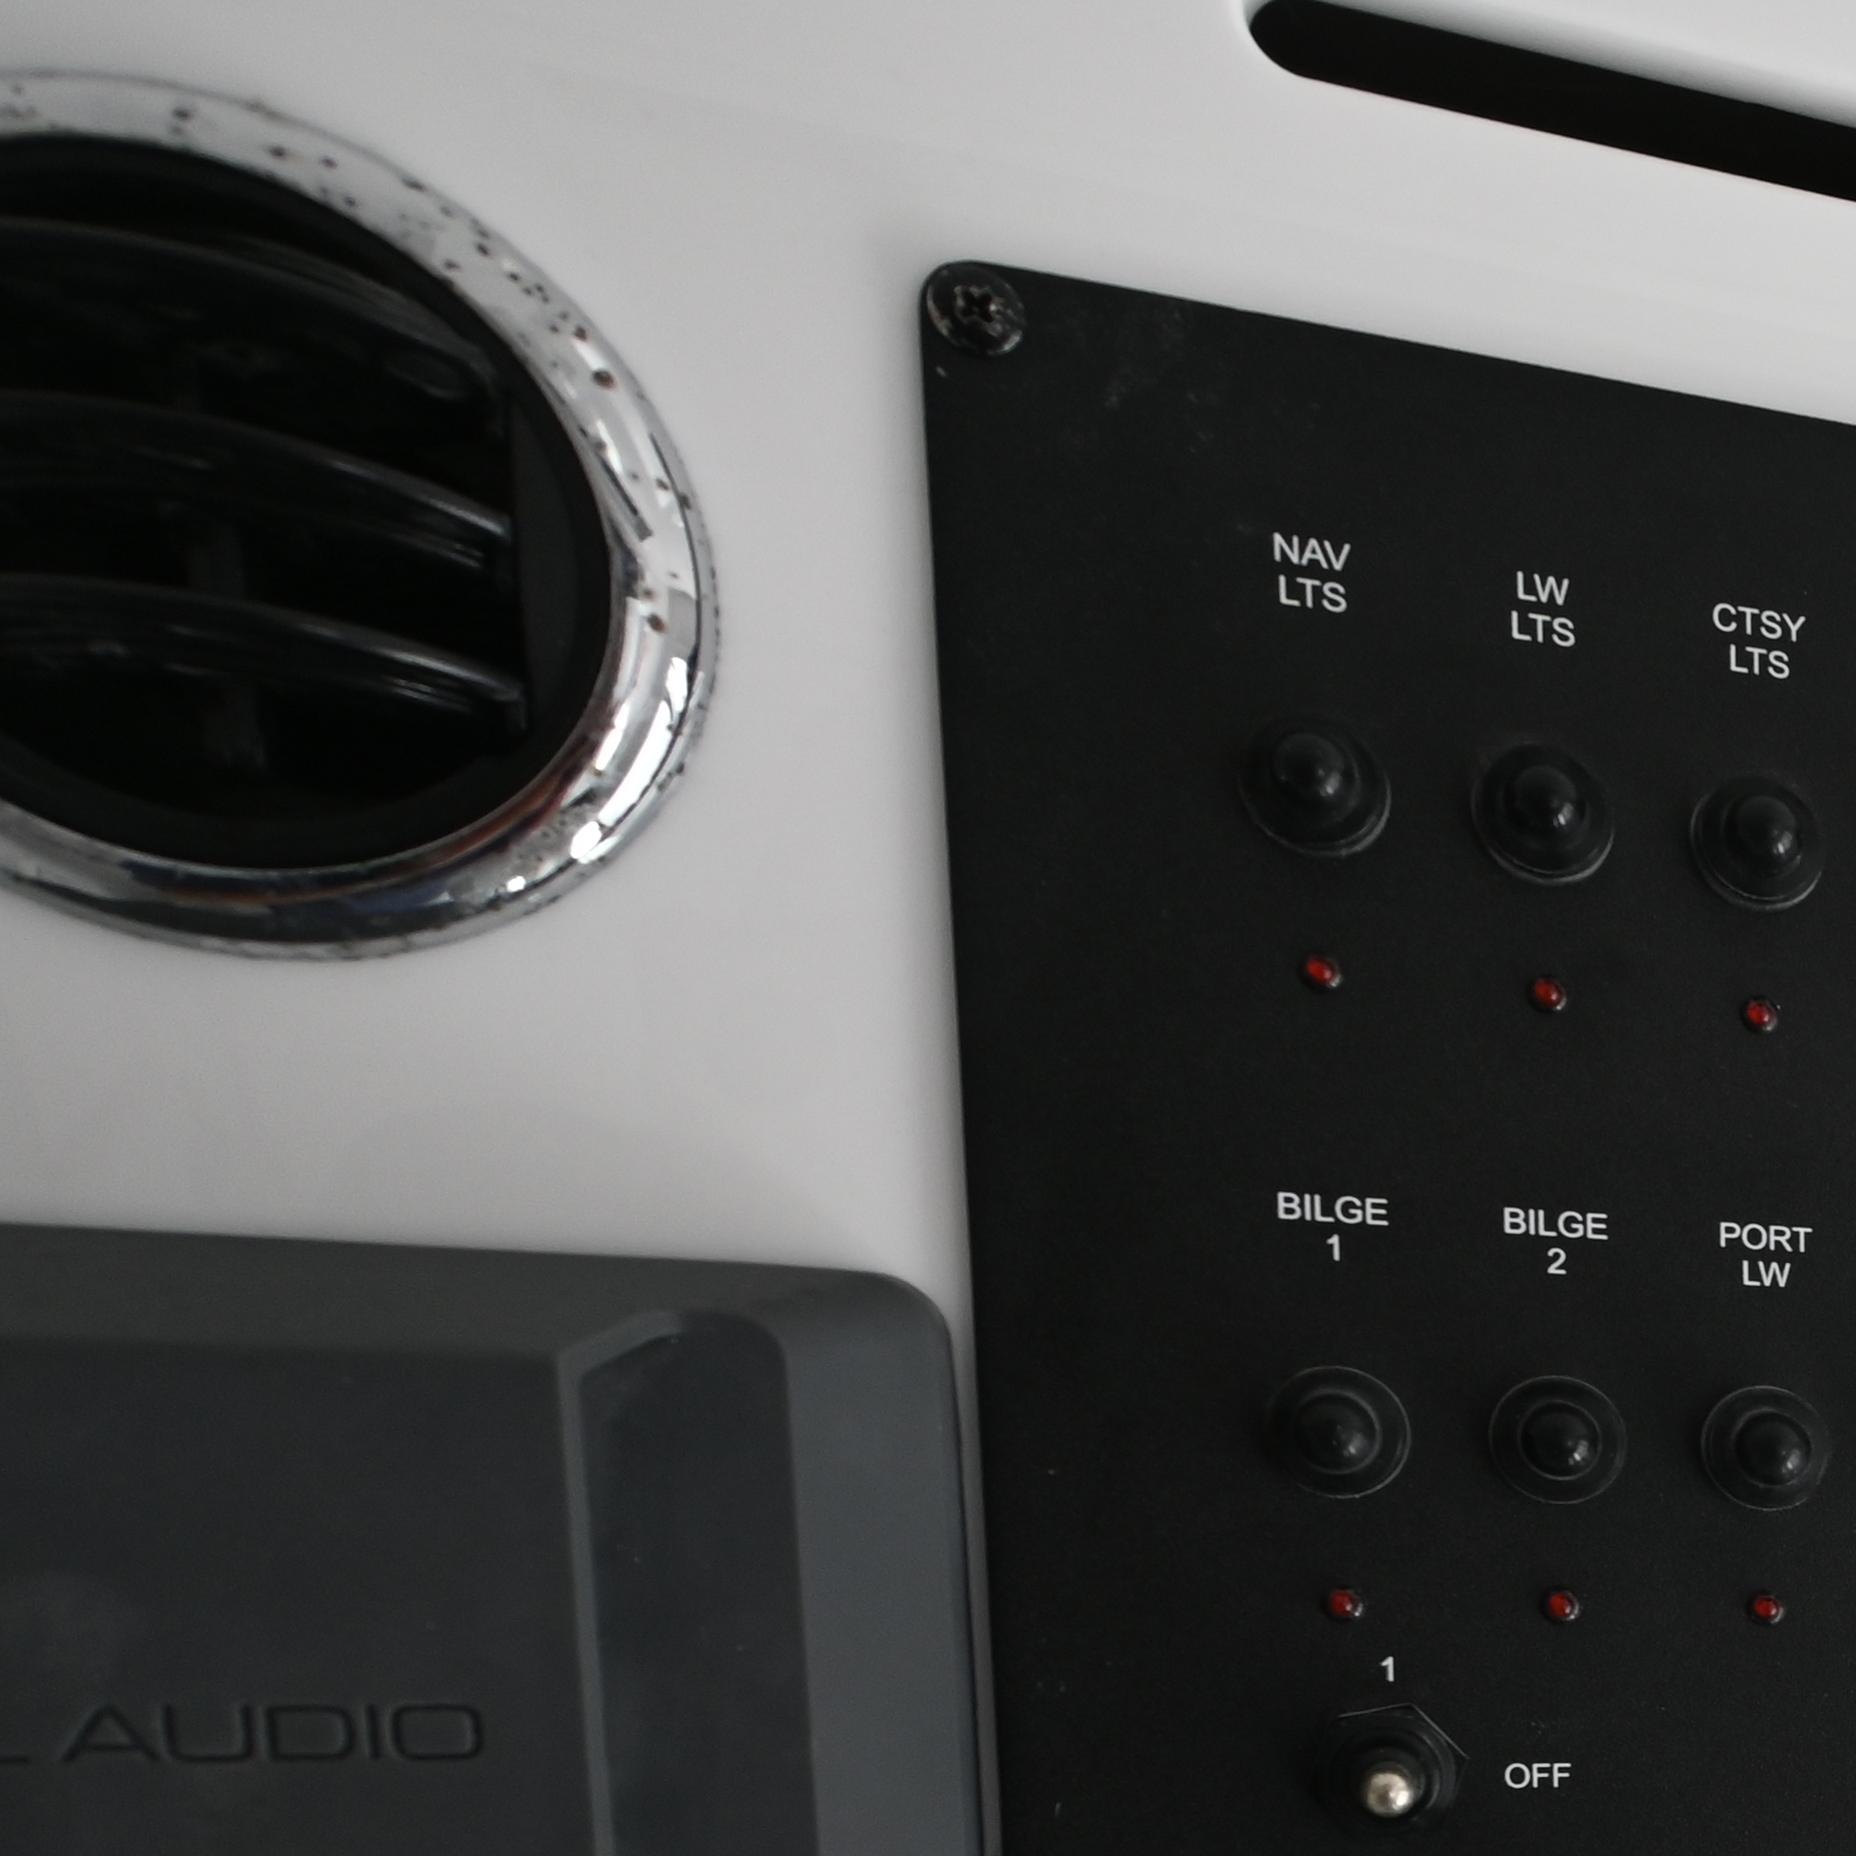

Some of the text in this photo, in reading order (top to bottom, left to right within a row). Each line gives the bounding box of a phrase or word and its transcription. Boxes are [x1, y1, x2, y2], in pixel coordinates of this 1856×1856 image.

[1273, 532, 1350, 571] NAV
[1279, 575, 1347, 612] LTS
[1517, 571, 1569, 605] LW
[1511, 611, 1575, 647] LTS
[1713, 603, 1805, 642] CTSY
[1730, 644, 1789, 679] LTS
[1277, 1192, 1389, 1225] BILGE
[1504, 1207, 1608, 1240] BILGE
[1327, 1234, 1340, 1261] 1
[1720, 1222, 1813, 1252] PORT
[1547, 1248, 1566, 1274] 2
[1742, 1260, 1791, 1287] LW
[1381, 1657, 1394, 1681] 1
[63, 1702, 485, 1765] AUDIO
[1505, 1763, 1571, 1788] OFF
